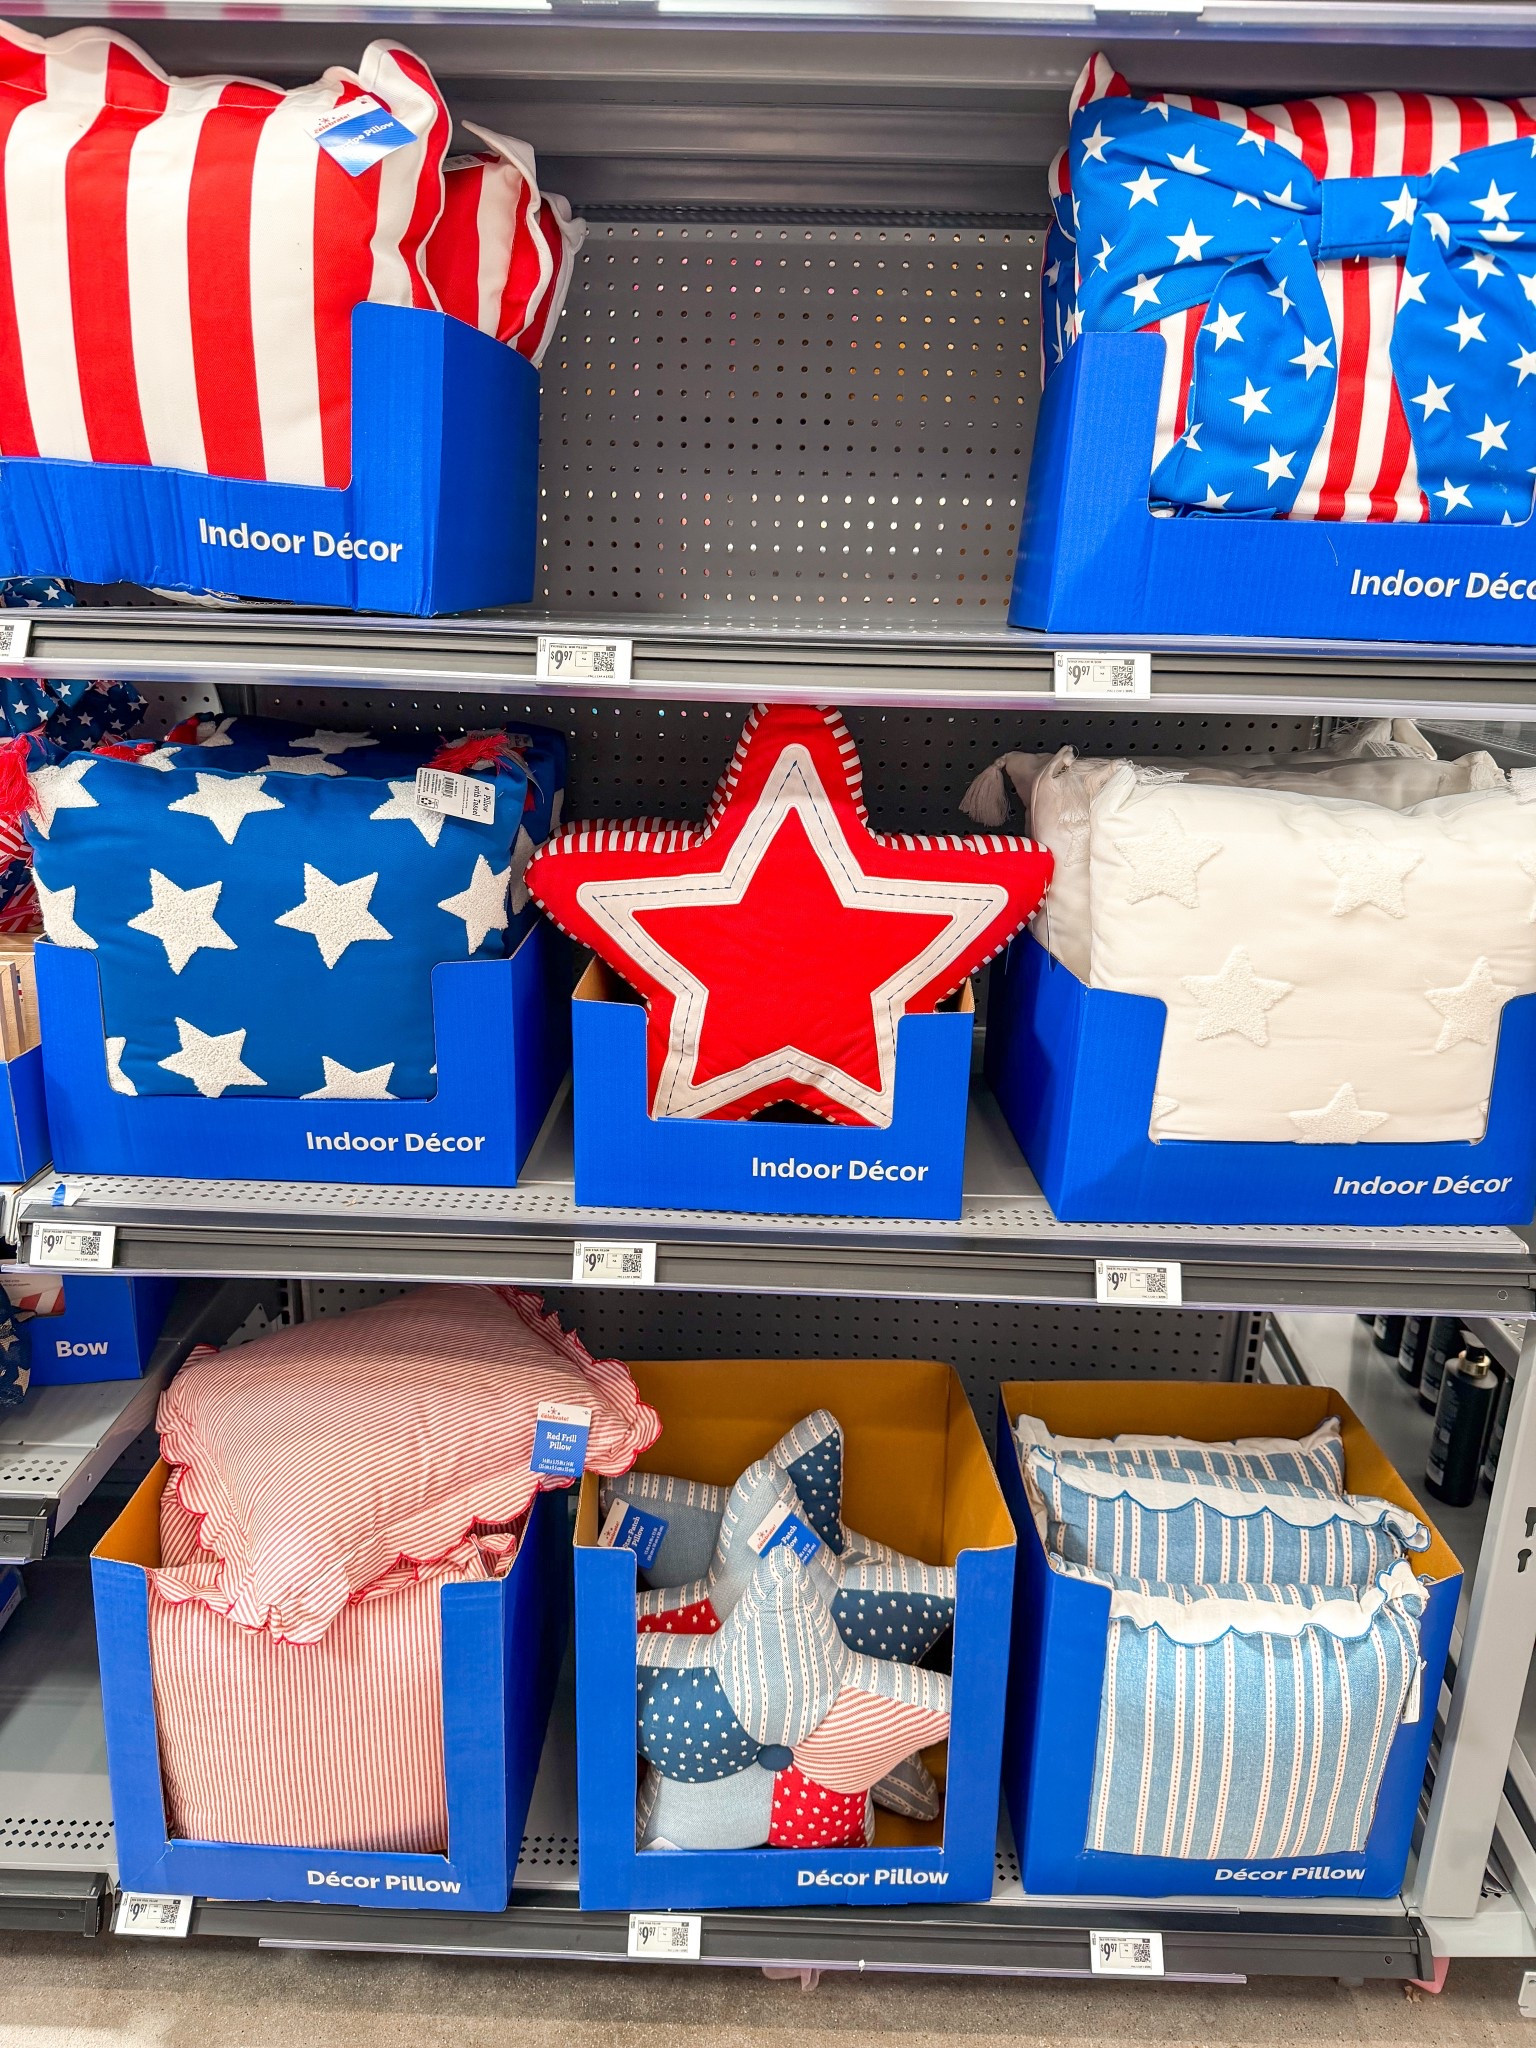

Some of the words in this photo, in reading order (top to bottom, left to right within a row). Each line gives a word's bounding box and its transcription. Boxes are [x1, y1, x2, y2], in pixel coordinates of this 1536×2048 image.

[363, 121, 394, 137] Pillow
[199, 518, 306, 554] Indoor
[313, 530, 403, 563] Décor
[1350, 569, 1461, 598] Indoor
[306, 1131, 399, 1152] Indoor
[405, 1132, 486, 1153] Décor
[752, 1157, 843, 1179] Indoor
[849, 1160, 929, 1182] Décor
[1333, 1175, 1429, 1196] Indoor
[1432, 1175, 1513, 1196] Décor
[56, 1340, 108, 1357] Bow
[546, 1431, 561, 1440] Red
[561, 1433, 577, 1443] Frill
[549, 1441, 572, 1451] Pillow
[628, 1516, 640, 1535] Patch
[780, 1525, 797, 1544] Patch
[631, 1525, 645, 1547] Pillow
[307, 1870, 381, 1889] Décor
[385, 1874, 461, 1894] Pillow
[797, 1868, 870, 1886] Décor
[874, 1868, 949, 1885] Pillow
[1215, 1867, 1288, 1881] Décor
[1291, 1866, 1366, 1880] Pillow
